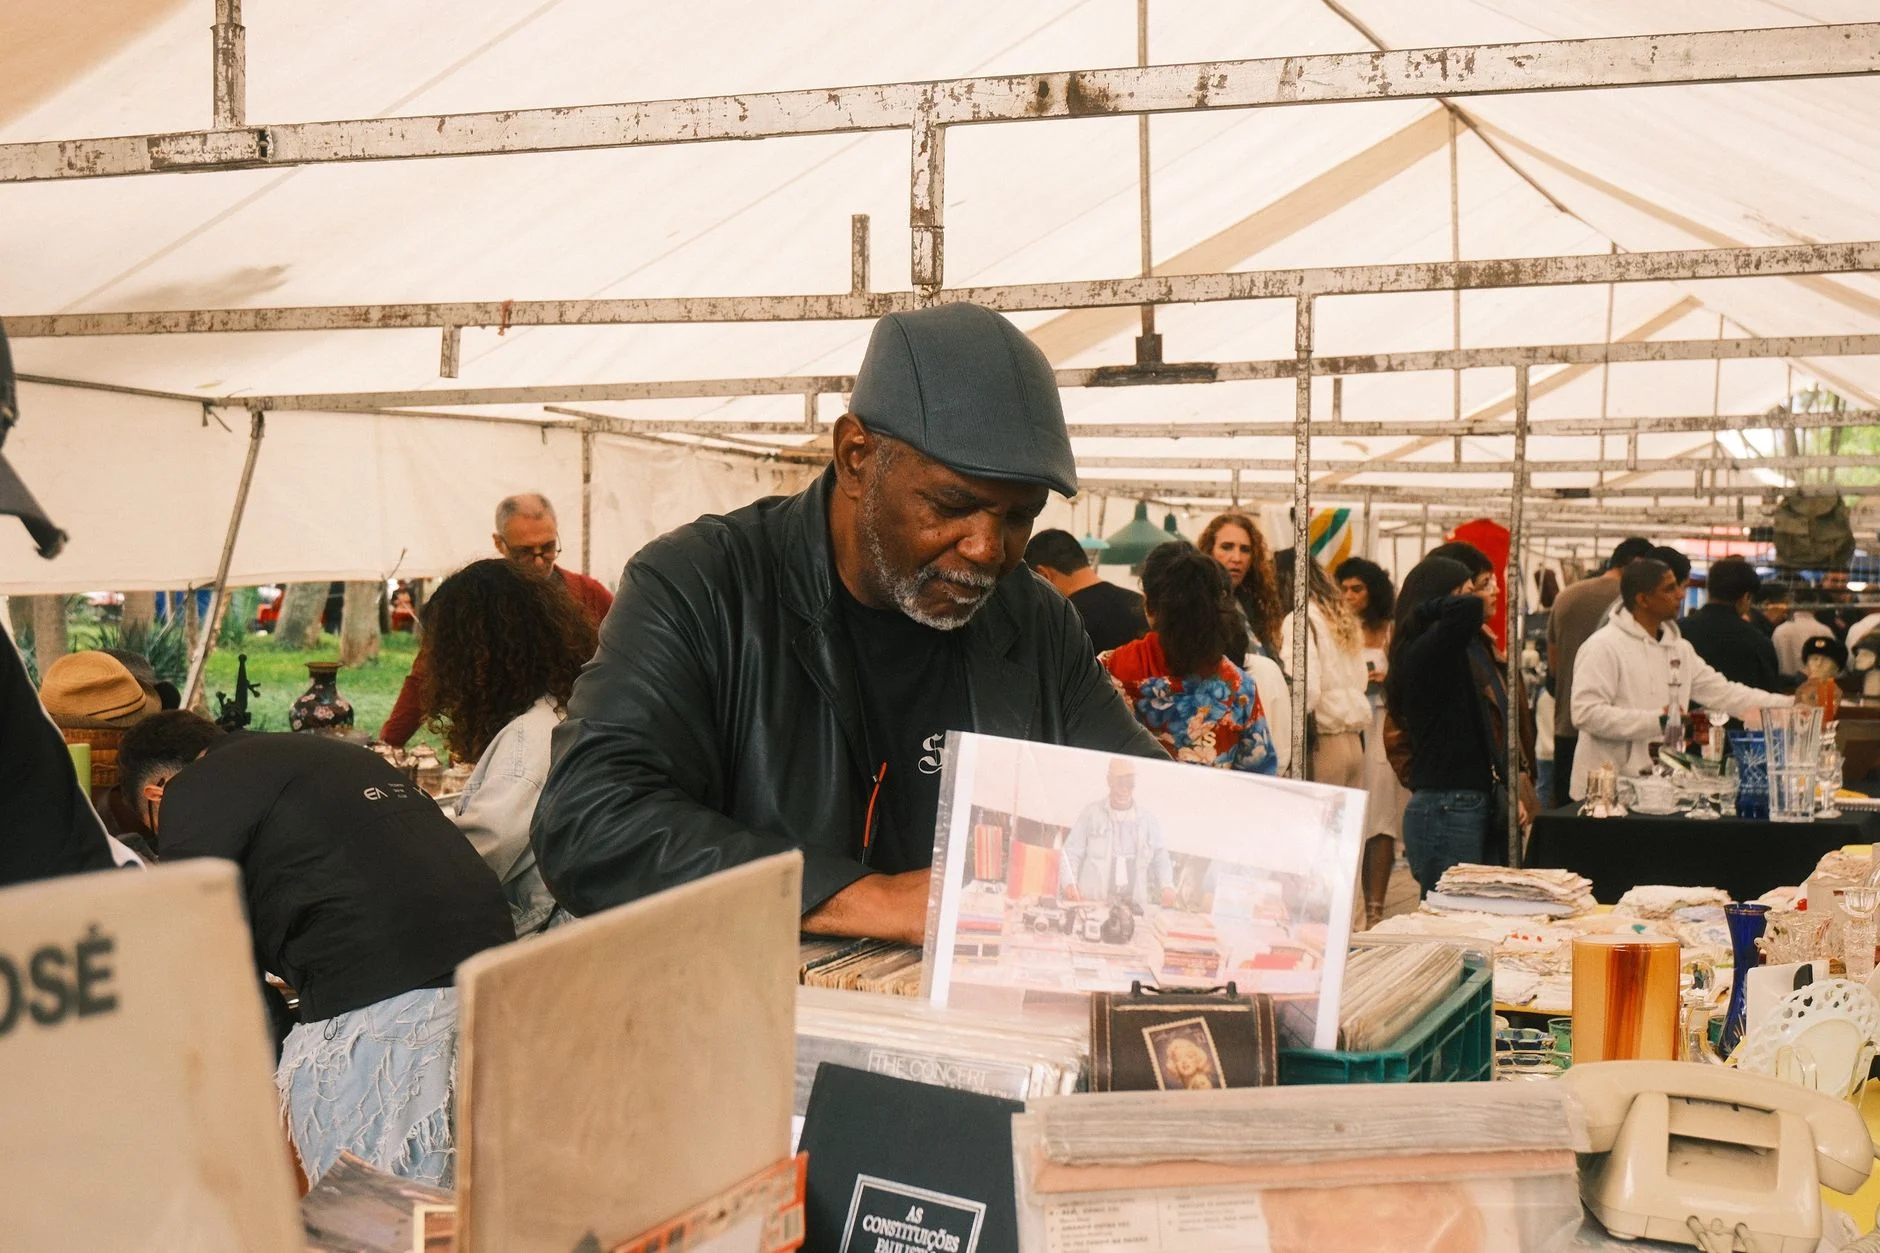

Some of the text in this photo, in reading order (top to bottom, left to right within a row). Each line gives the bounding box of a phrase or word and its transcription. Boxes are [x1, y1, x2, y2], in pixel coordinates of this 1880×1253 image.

[874, 1053, 986, 1087] THE CONCERT
[905, 1204, 924, 1224] AS
[862, 1214, 960, 1253] CONSTITUIÇÕES
